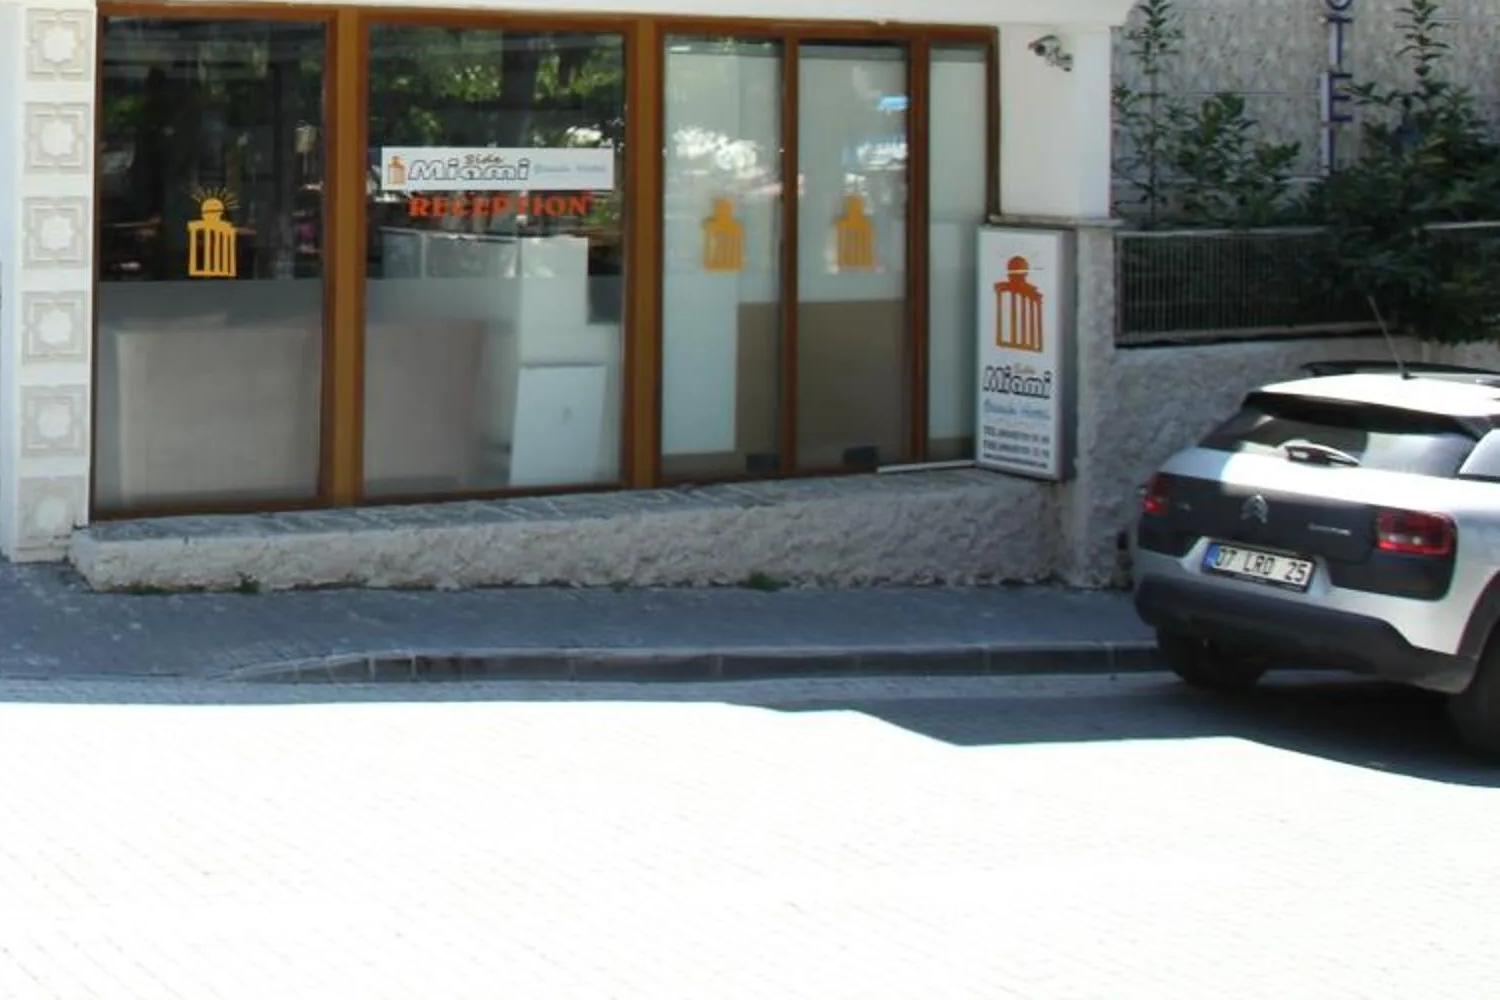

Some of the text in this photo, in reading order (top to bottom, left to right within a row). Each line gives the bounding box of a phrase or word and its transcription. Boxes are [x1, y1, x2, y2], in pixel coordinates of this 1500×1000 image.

[407, 157, 531, 181] Miami
[408, 192, 592, 217] RECEPTION
[1284, 561, 1309, 583] 25
